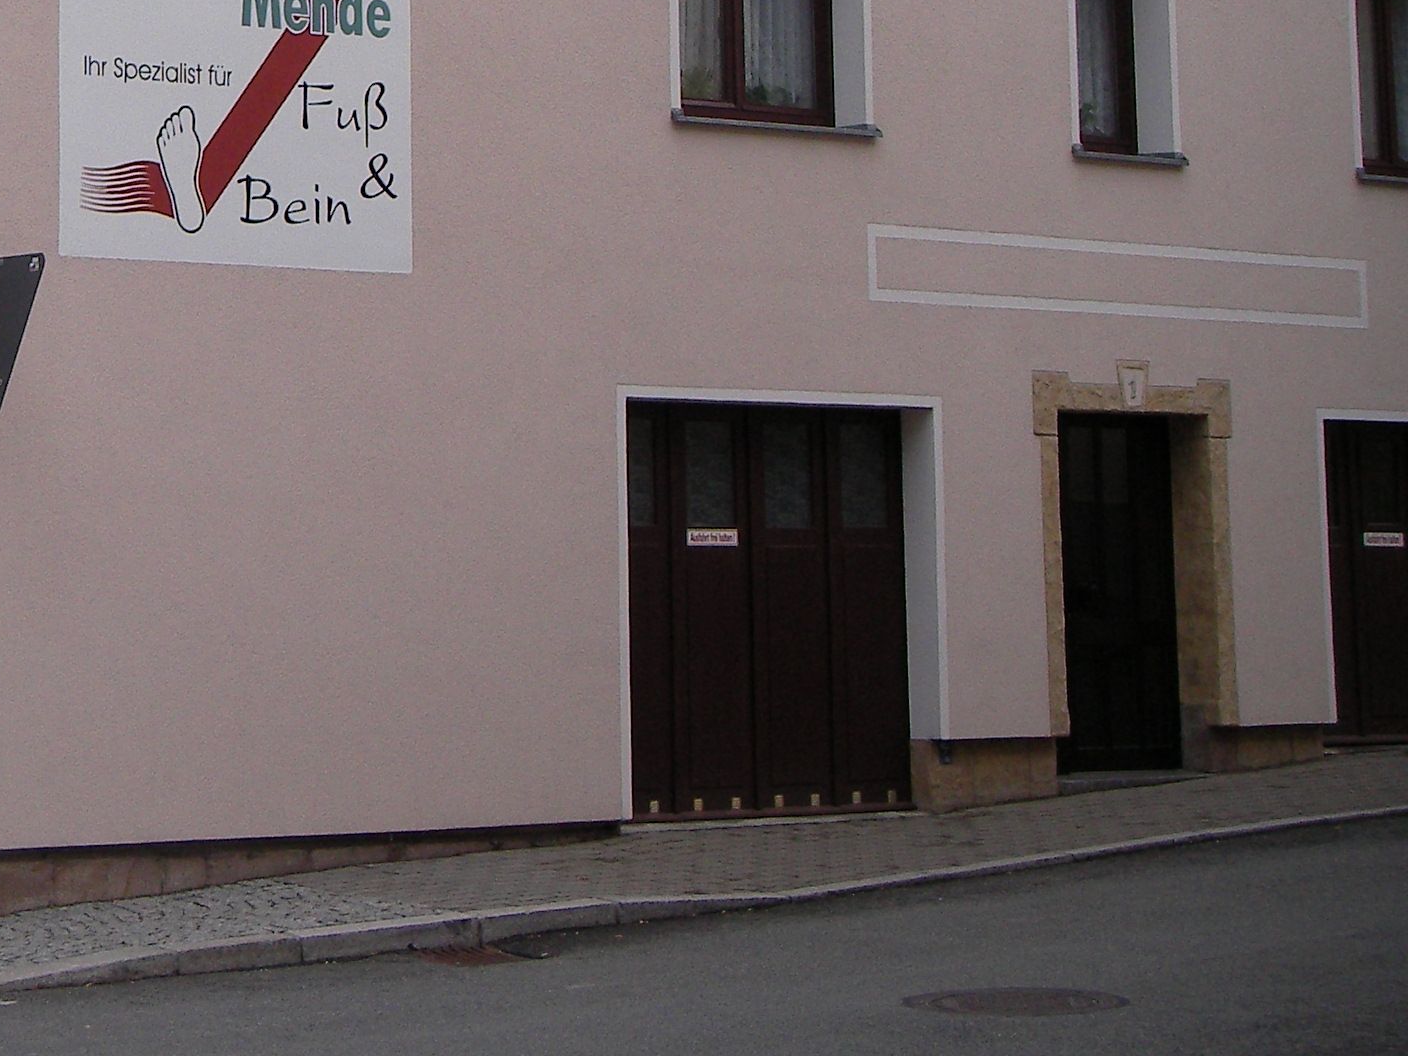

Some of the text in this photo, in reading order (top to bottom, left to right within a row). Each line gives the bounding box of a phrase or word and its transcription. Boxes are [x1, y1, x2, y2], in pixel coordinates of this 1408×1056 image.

[83, 55, 233, 88] Ihr Spezialist für
[297, 81, 388, 147] Fuß
[360, 152, 398, 199] &
[237, 175, 352, 226] Bein
